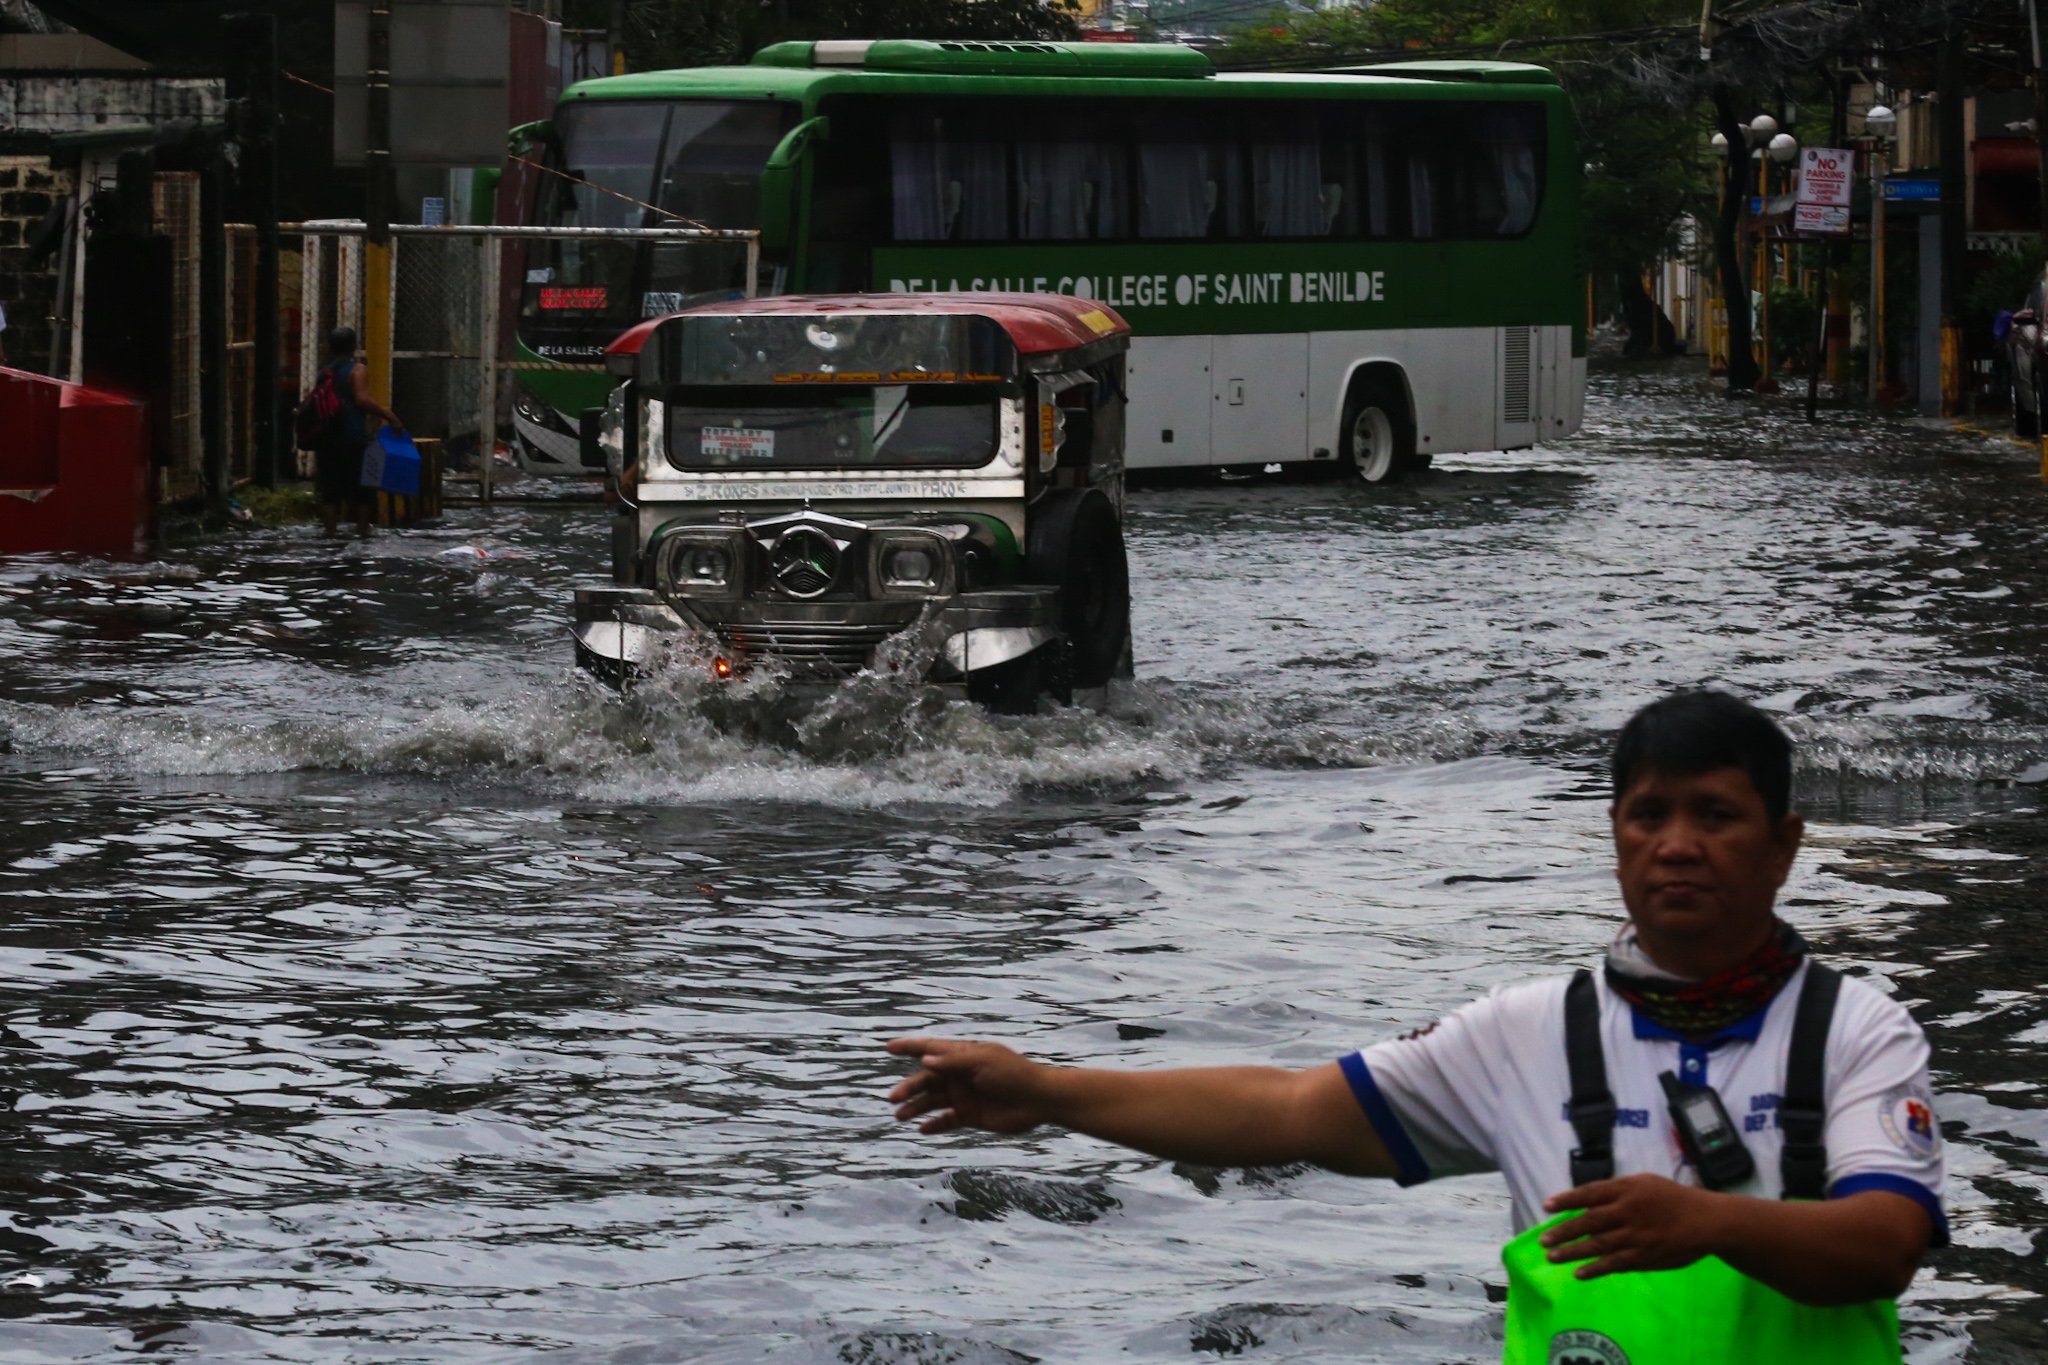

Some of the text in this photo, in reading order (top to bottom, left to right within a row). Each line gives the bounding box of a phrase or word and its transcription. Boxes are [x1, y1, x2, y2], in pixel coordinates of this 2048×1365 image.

[1817, 158, 1837, 170] NO
[1807, 169, 1846, 180] PARKING
[1174, 274, 1208, 306] OF
[1213, 273, 1283, 304] SAINT
[1289, 271, 1385, 303] BENILDE
[538, 345, 551, 355] DE
[551, 345, 564, 355] LA
